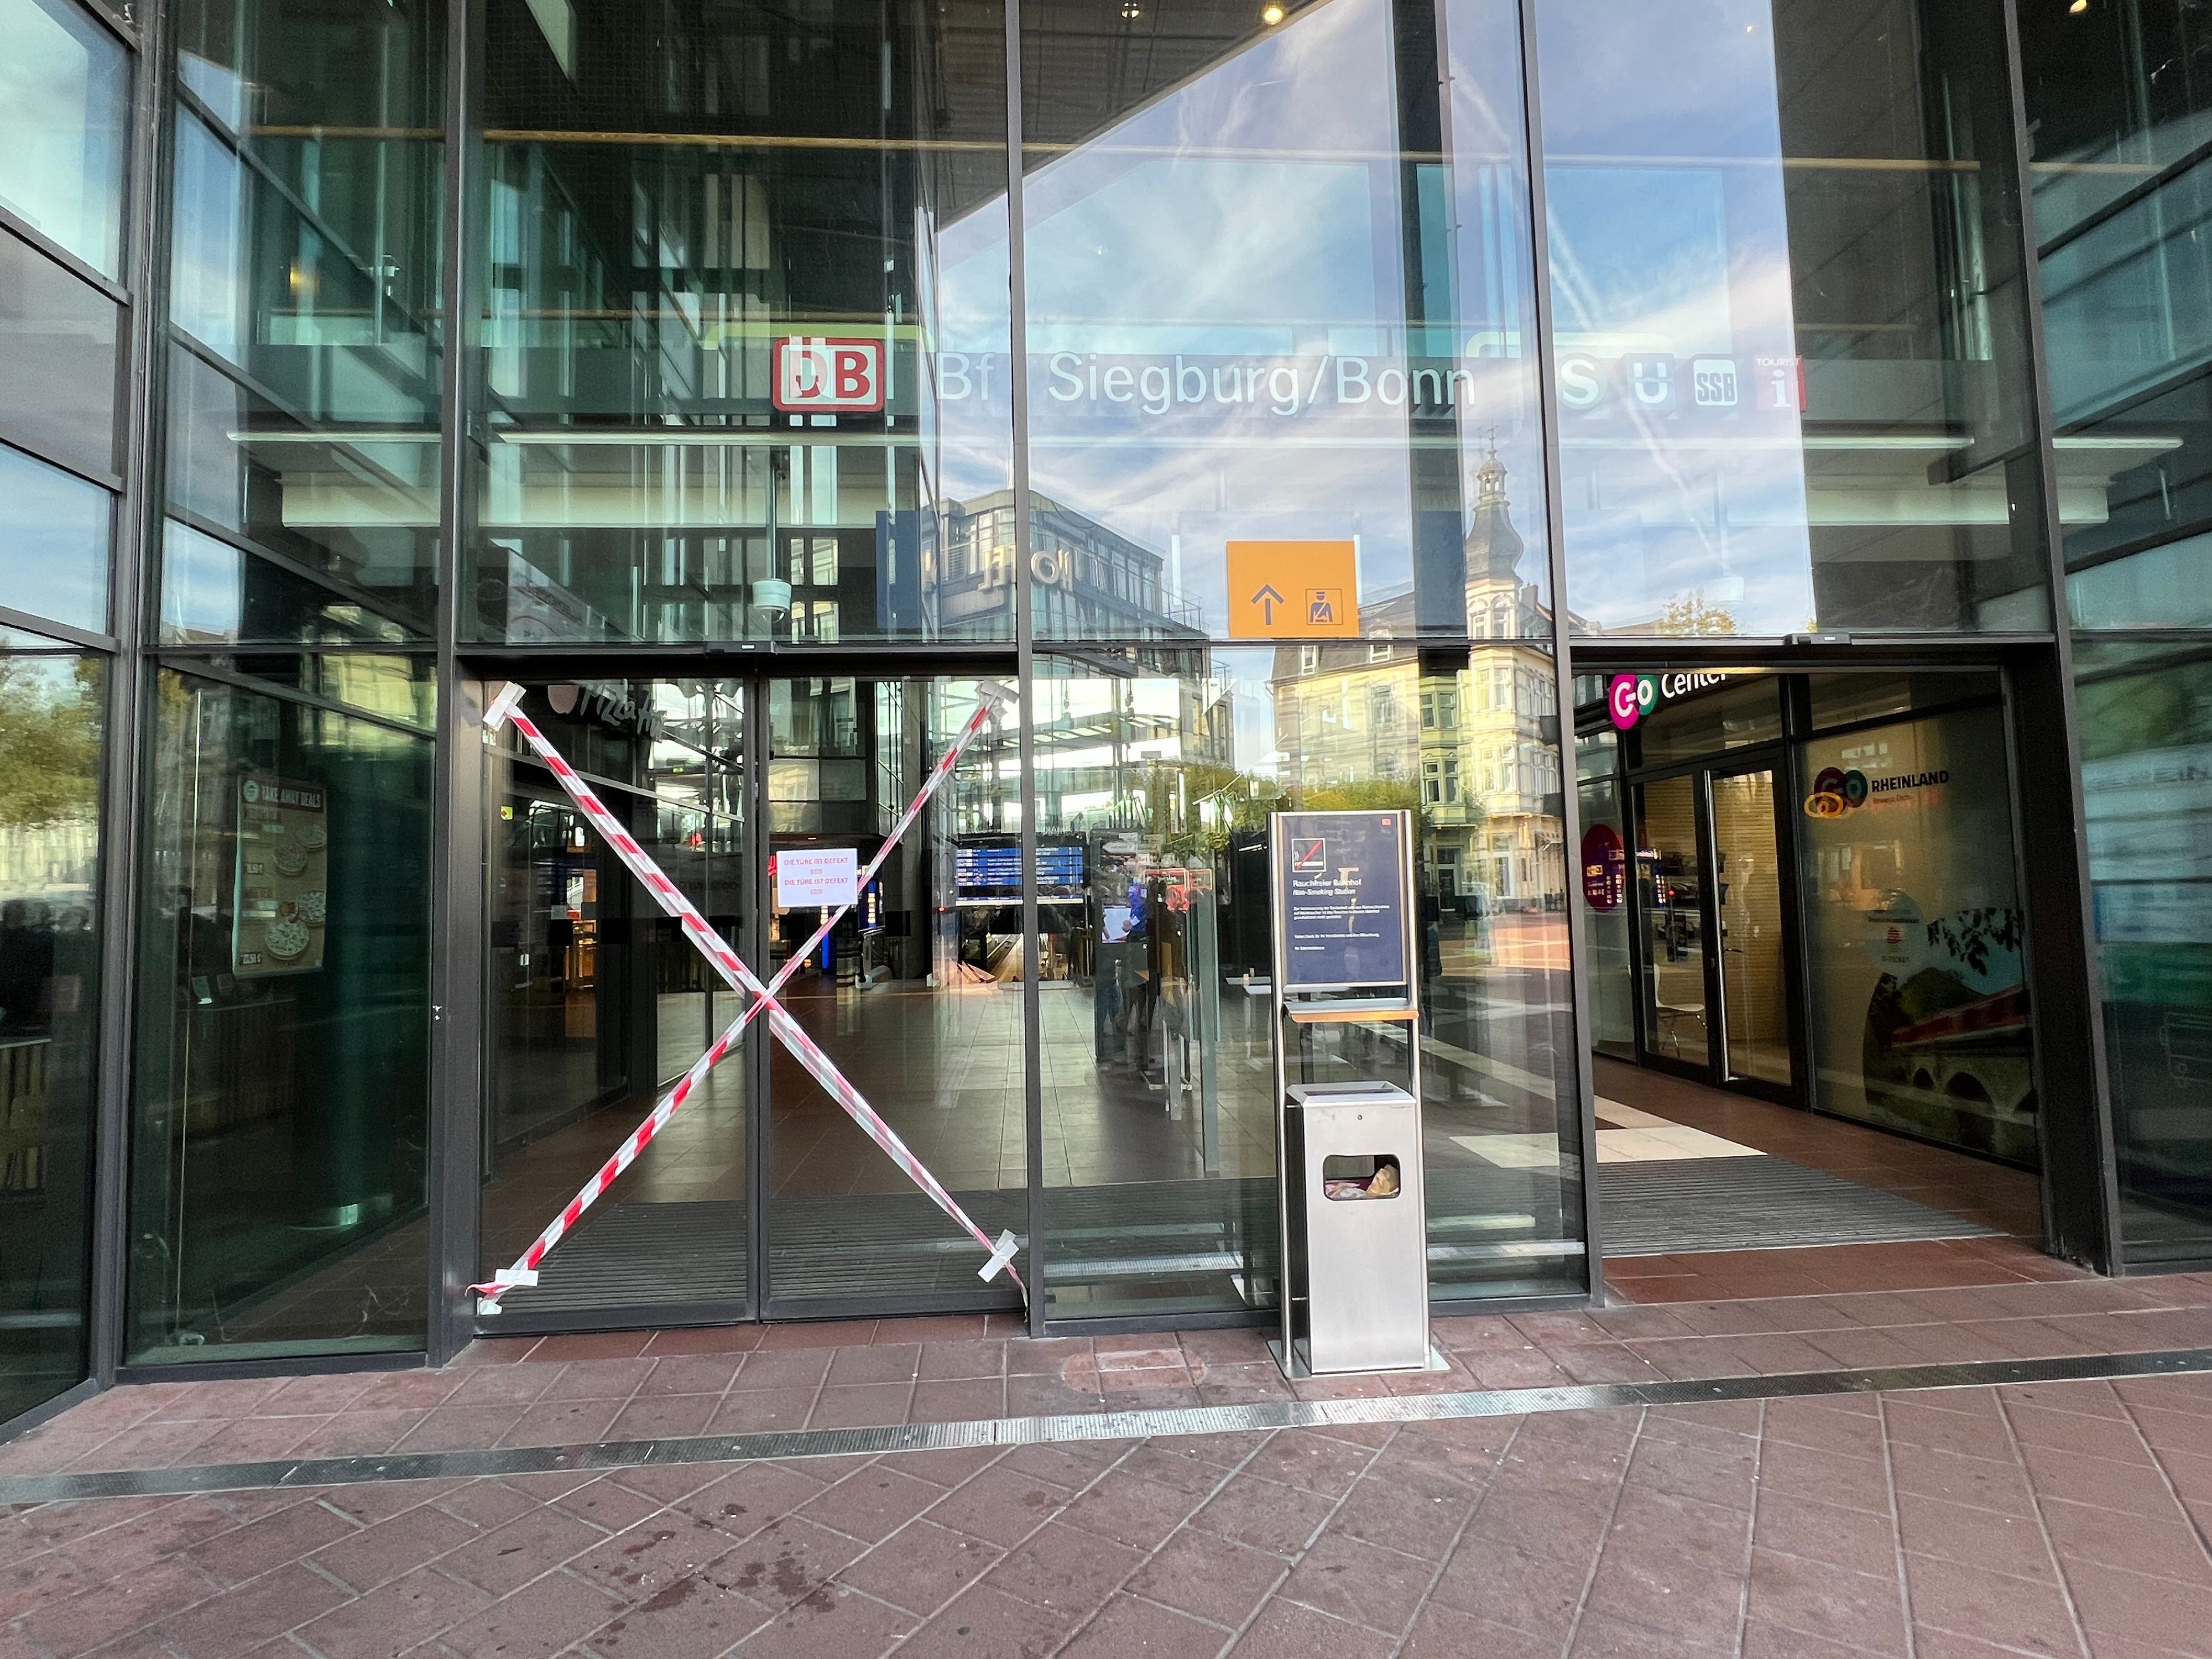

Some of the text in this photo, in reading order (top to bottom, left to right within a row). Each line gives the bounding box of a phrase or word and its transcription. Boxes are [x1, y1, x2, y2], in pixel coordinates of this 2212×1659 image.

[793, 350, 871, 399] DB
[1756, 358, 1800, 367] TOURIST
[938, 351, 1476, 415] Bf Siegburg/Bonn
[1695, 373, 1735, 403] SSB
[1871, 770, 1950, 792] RHEINLAND
